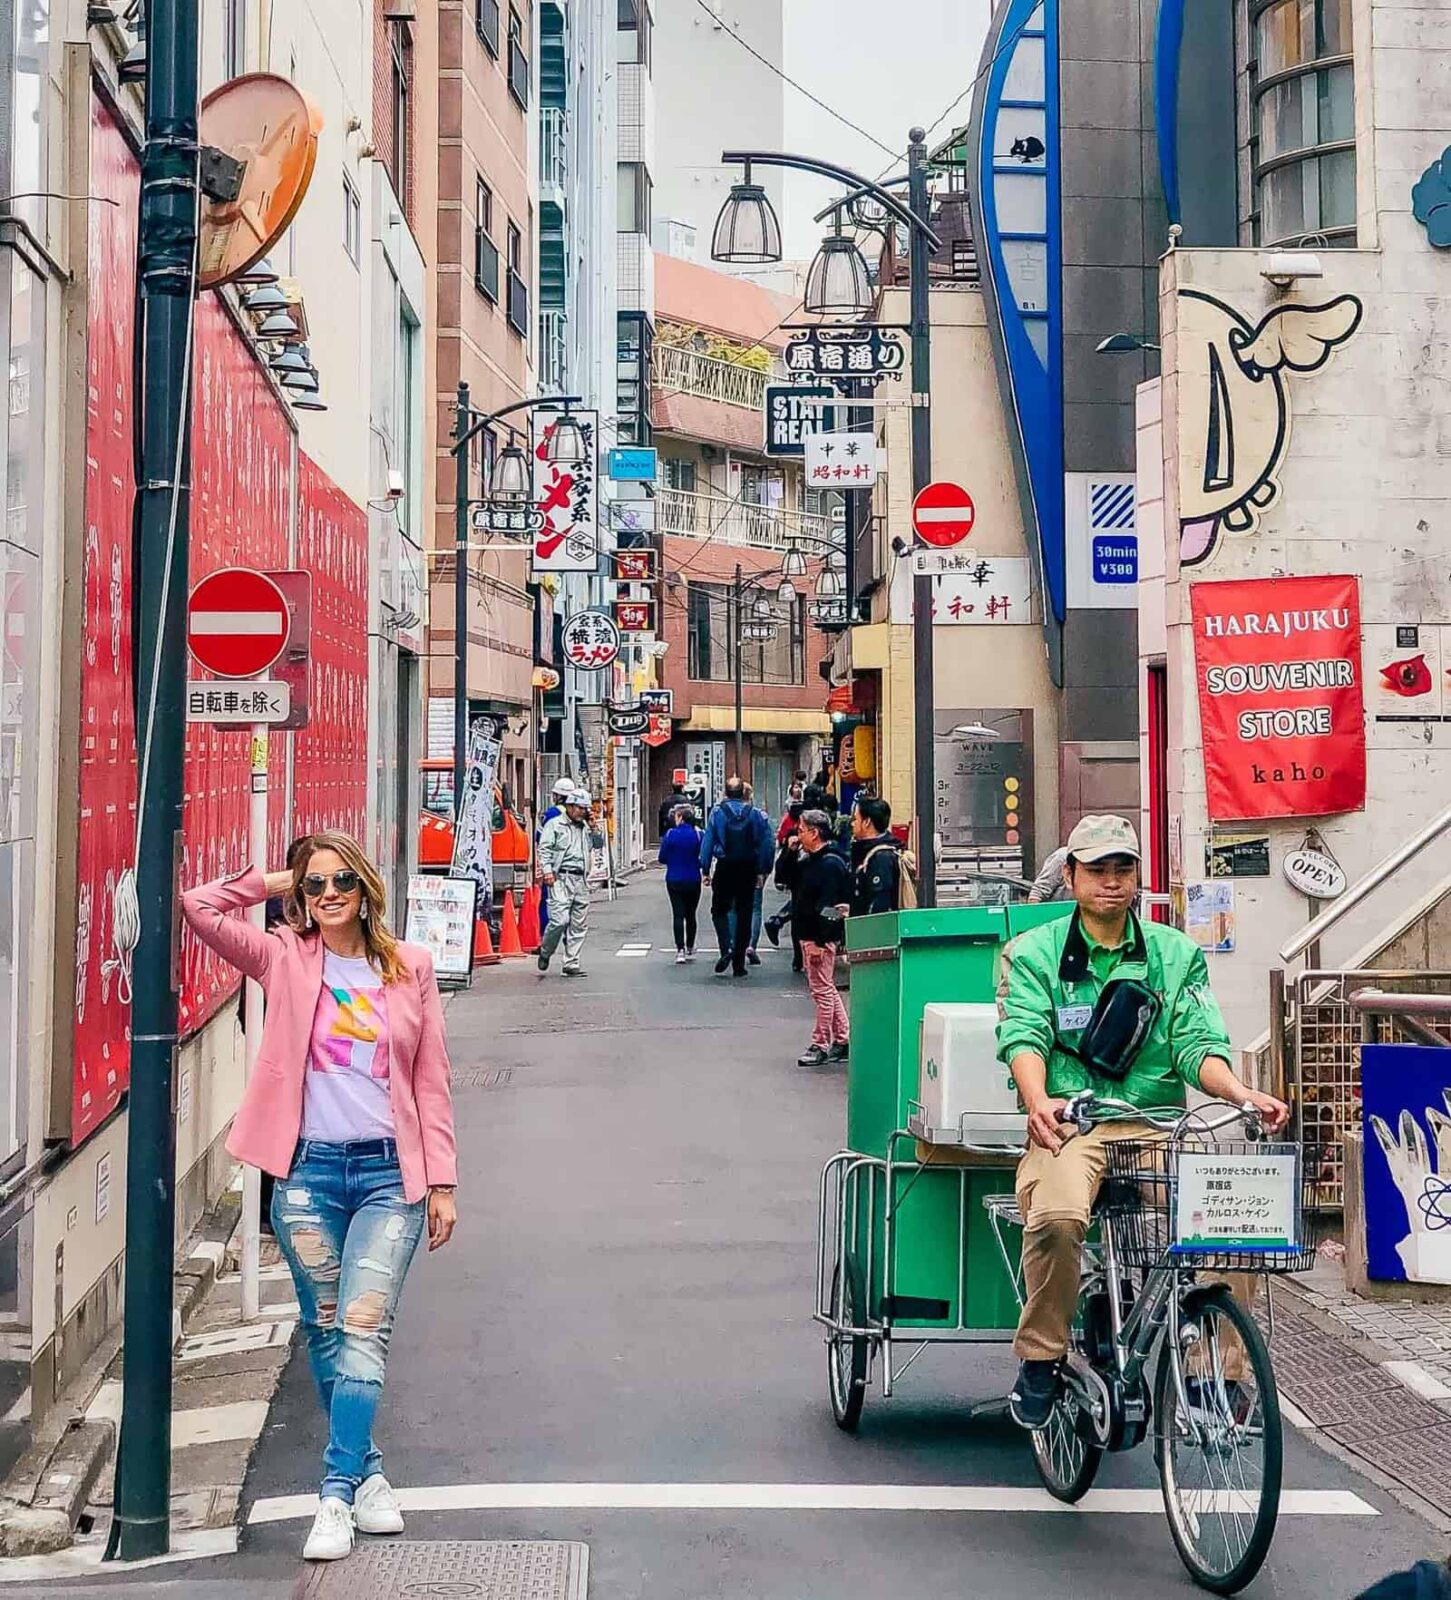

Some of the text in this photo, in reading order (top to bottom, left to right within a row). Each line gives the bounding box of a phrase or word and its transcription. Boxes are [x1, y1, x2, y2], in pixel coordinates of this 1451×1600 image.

[790, 344, 901, 370] 原宿通り
[773, 396, 827, 420] STAY
[820, 442, 862, 459] 中華
[813, 464, 871, 480] 昭和軒
[536, 424, 576, 559] メン
[475, 512, 543, 528] 原宿通り
[1096, 546, 1137, 558] 30min
[910, 595, 1012, 620] 和軒
[1205, 608, 1349, 638] HARAJUKU
[571, 645, 616, 666] ラーメン
[1207, 660, 1353, 694] SOUVENIR
[190, 691, 280, 713] 自転車を除く
[1239, 707, 1331, 740] STORE
[1252, 763, 1325, 783] kaho
[1292, 858, 1339, 886] OPEN
[1206, 1207, 1270, 1218] カルロス・ケイン
